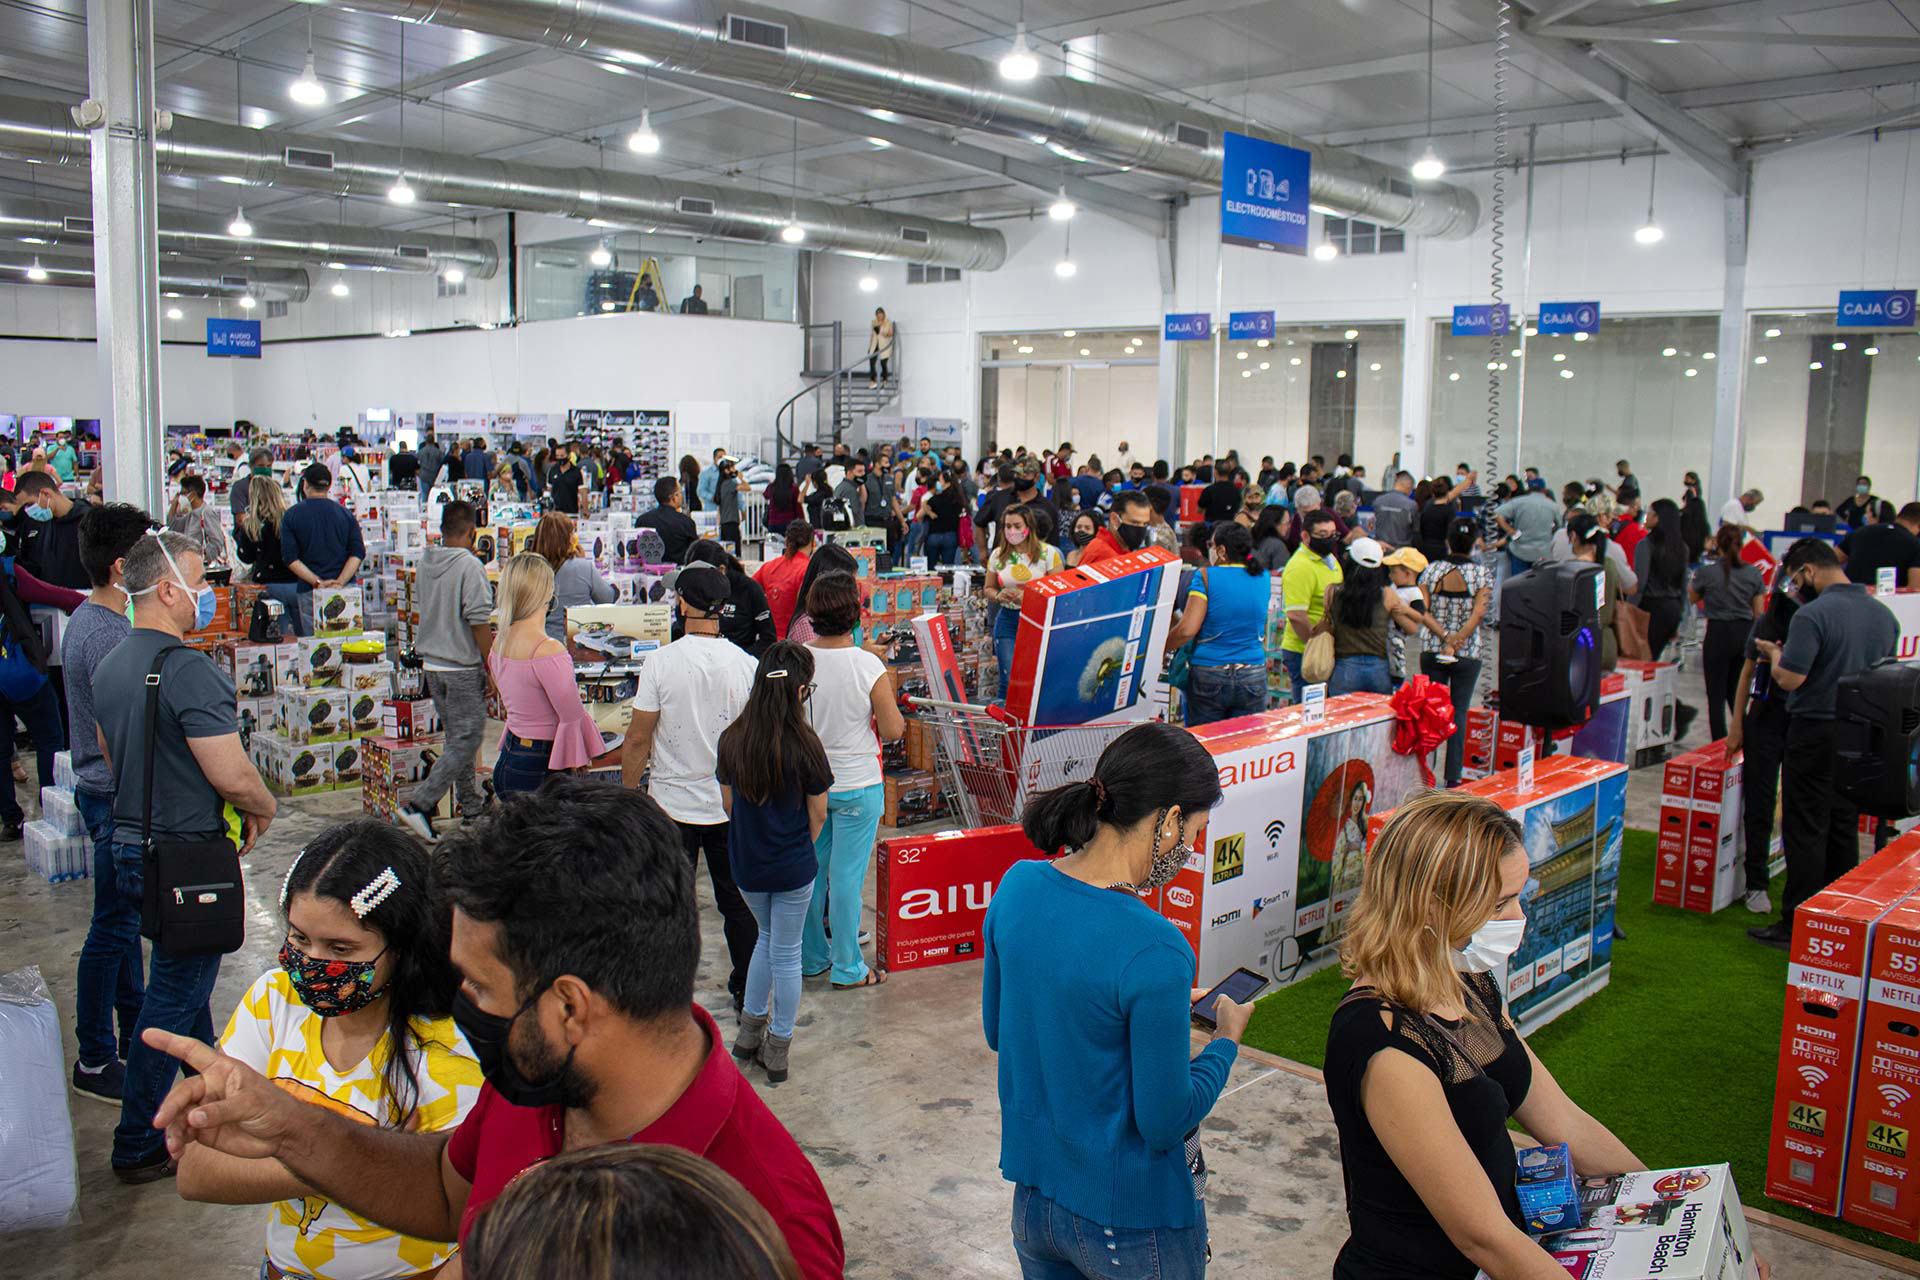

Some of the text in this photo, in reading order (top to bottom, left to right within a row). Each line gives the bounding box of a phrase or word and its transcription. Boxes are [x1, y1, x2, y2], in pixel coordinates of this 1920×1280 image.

[1226, 200, 1306, 225] ELECTRODOMÉSTICOS
[1844, 301, 1903, 315] CAJA 5
[1232, 319, 1268, 331] CAJA 2
[1456, 316, 1485, 326] CAJA
[1543, 311, 1590, 323] CAJA 4
[1168, 321, 1202, 332] CAJA 1
[498, 416, 516, 424] CCTV
[934, 622, 948, 651] aiwa
[1219, 751, 1295, 789] aiwa
[1669, 775, 1688, 785] 43"
[1700, 780, 1719, 790] 43"
[897, 847, 927, 864] 32"
[1217, 837, 1242, 867] 4K
[1213, 866, 1243, 883] ULTRA HD
[1171, 890, 1192, 904] USB
[1263, 889, 1291, 906] Smart TV
[1212, 909, 1241, 927] HDMI
[1299, 906, 1326, 928] NETFLIX
[1806, 919, 1851, 935] aiwa
[920, 933, 947, 944] soporte
[947, 932, 956, 940] de
[956, 930, 975, 940] pared
[1888, 934, 1920, 948] aiw
[923, 946, 950, 956] HDMI
[1808, 937, 1846, 957] 55"
[896, 950, 918, 964] LED
[1510, 971, 1530, 993] NETFLIX
[1801, 971, 1845, 990] NETFLIX
[1796, 1023, 1836, 1040] HDMI
[1792, 1049, 1838, 1066] DIGITAL
[1813, 1045, 1837, 1056] DOLBY
[1876, 1040, 1920, 1058] HDMI
[1894, 1063, 1919, 1074] DOLBY
[1801, 1089, 1819, 1099] Wi-Fi
[1792, 1105, 1822, 1127] 4K
[1881, 1108, 1901, 1119] Wi-Fi
[1788, 1121, 1824, 1137] ULTRA HD
[1872, 1125, 1904, 1147] 4K
[1785, 1140, 1824, 1158] ISDB-T
[1867, 1141, 1905, 1158] ULTRA HD
[1864, 1160, 1907, 1180] ISDB-T
[1686, 1177, 1699, 1186] 2
[1673, 1203, 1703, 1258] Hamilton
[1648, 1234, 1677, 1274] Beach
